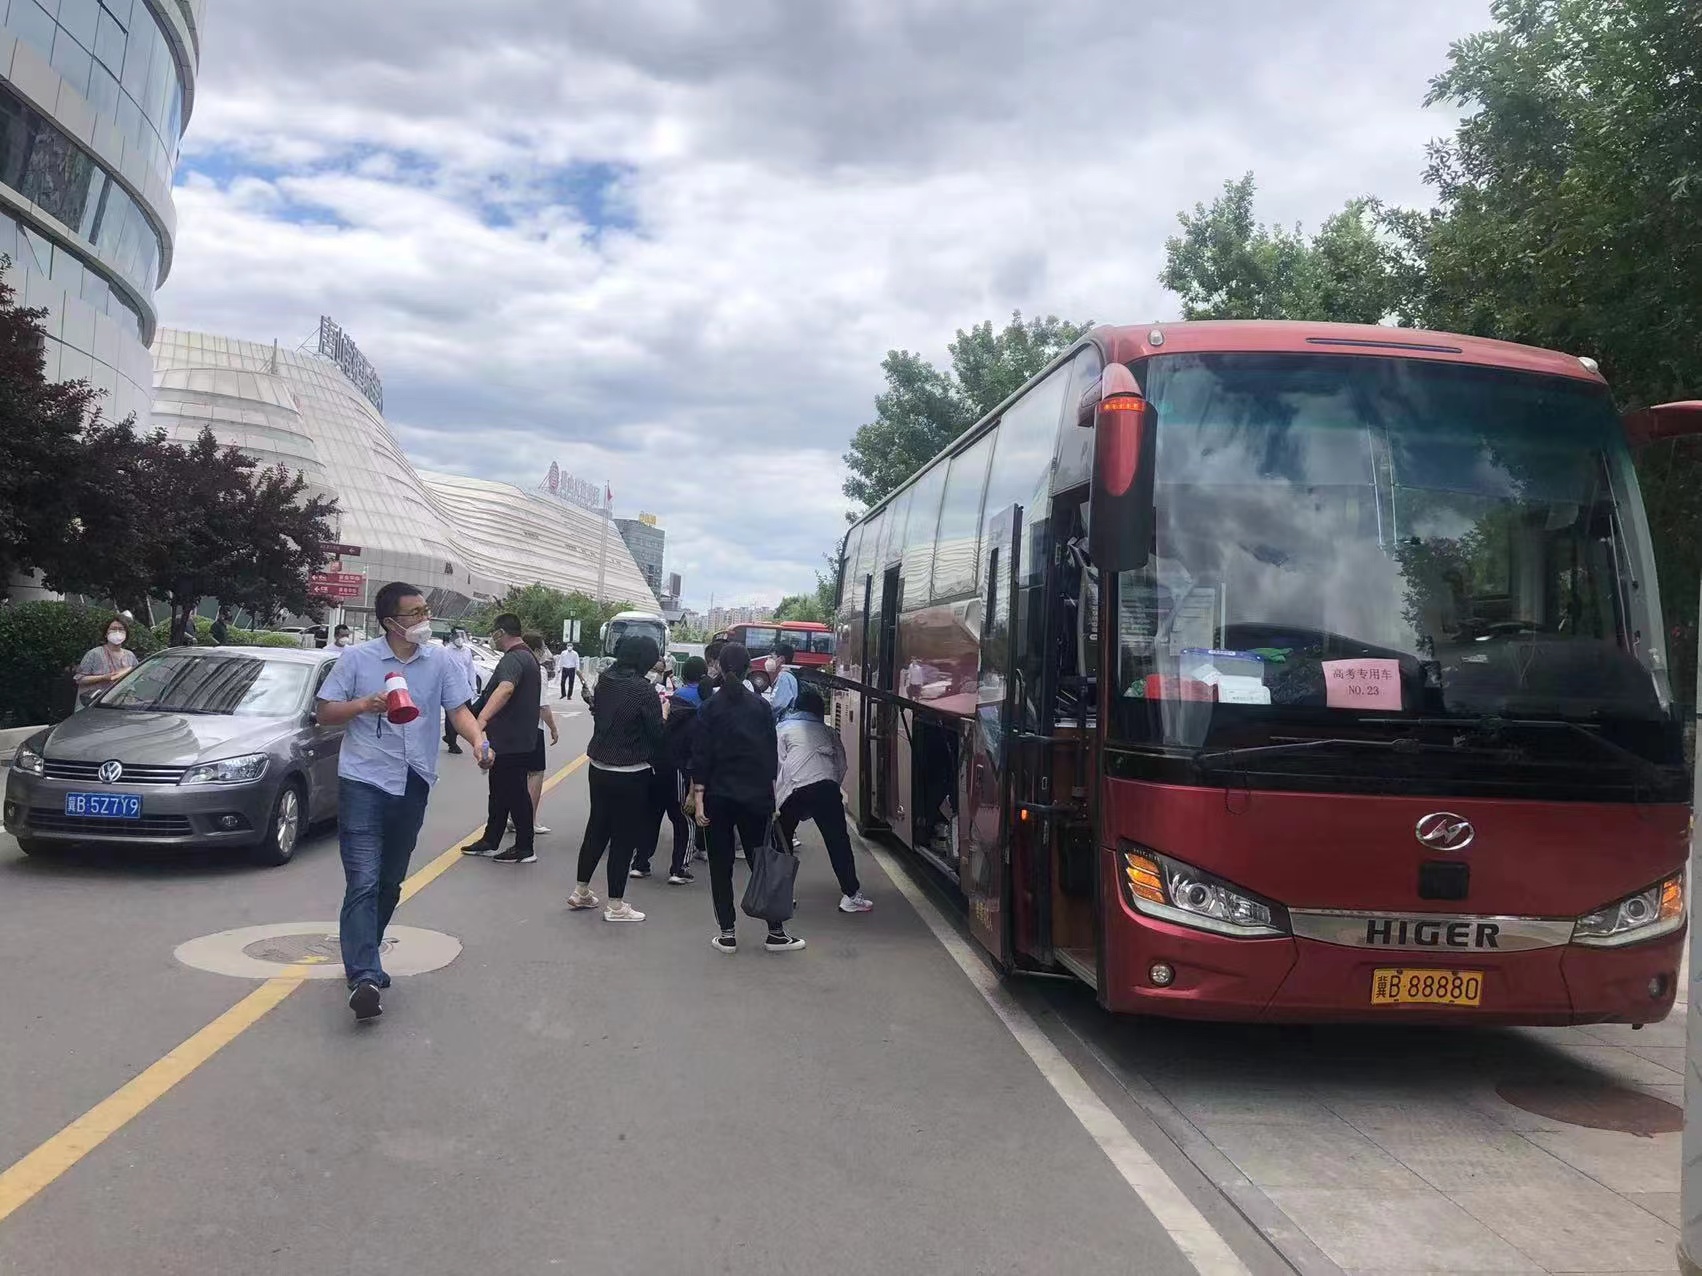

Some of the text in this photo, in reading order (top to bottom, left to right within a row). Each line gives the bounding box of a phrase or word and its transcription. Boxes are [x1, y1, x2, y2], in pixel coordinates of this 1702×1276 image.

[1333, 668, 1393, 680] 高考专用车
[1348, 685, 1380, 696] NO.23
[1366, 919, 1500, 948] HIGER
